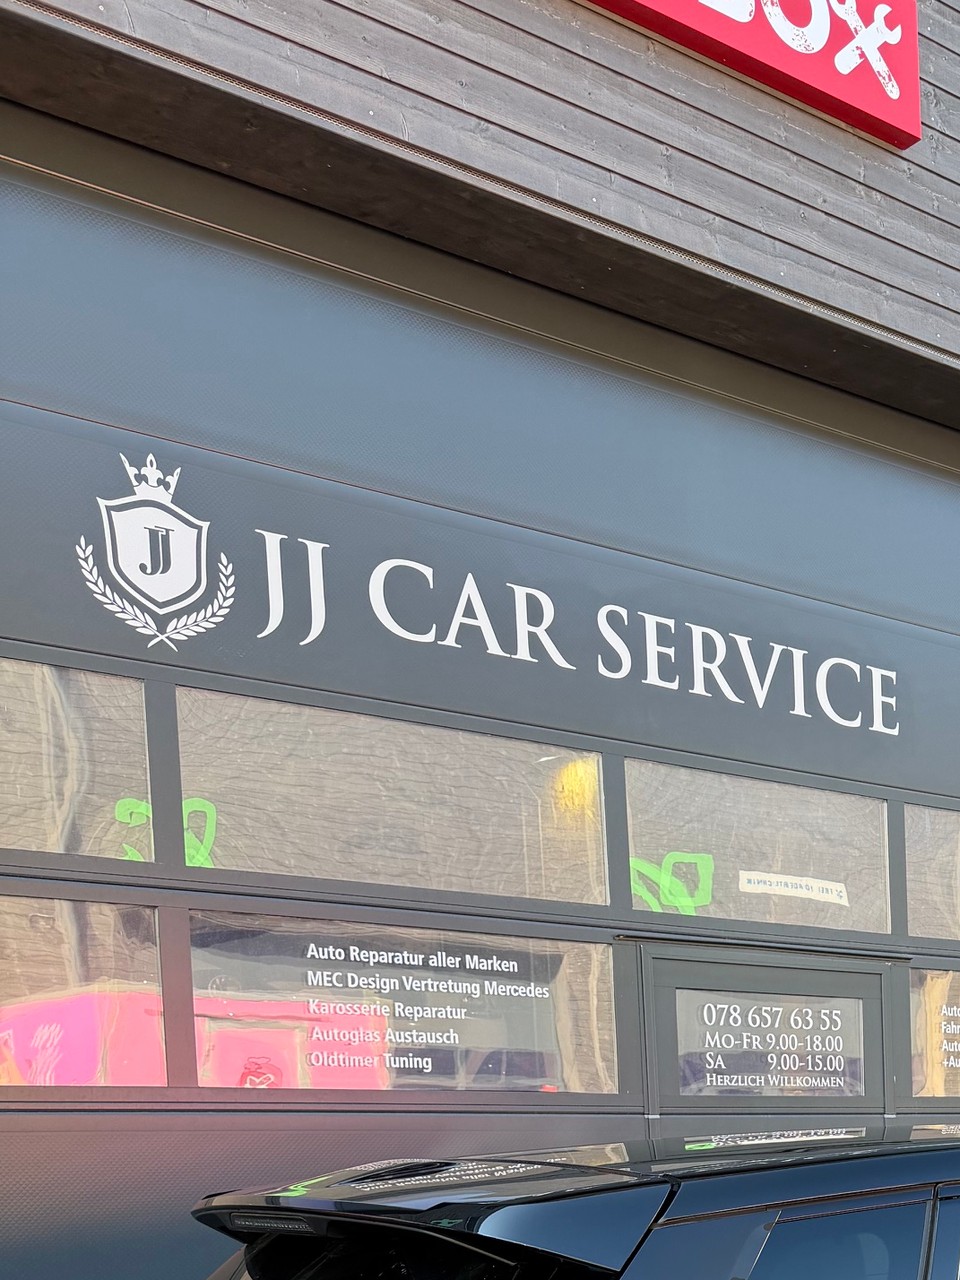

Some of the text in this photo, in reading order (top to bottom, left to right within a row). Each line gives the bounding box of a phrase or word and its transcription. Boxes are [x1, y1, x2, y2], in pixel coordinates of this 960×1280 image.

[254, 528, 900, 736] JJ CAR SERVICE
[307, 943, 519, 972] Auto Reparatur aller Marken
[307, 970, 550, 999] MEC Design Vertretung Mercedes
[308, 999, 467, 1021] Karosserie Reparatur
[703, 1003, 842, 1031] 078 657 63 55
[311, 1026, 460, 1046] Autoglas Austausch
[766, 1033, 844, 1052] 9.00-18.00
[310, 1051, 433, 1073] Oldtimer Tuning
[767, 1053, 845, 1072] 9.00-15.00
